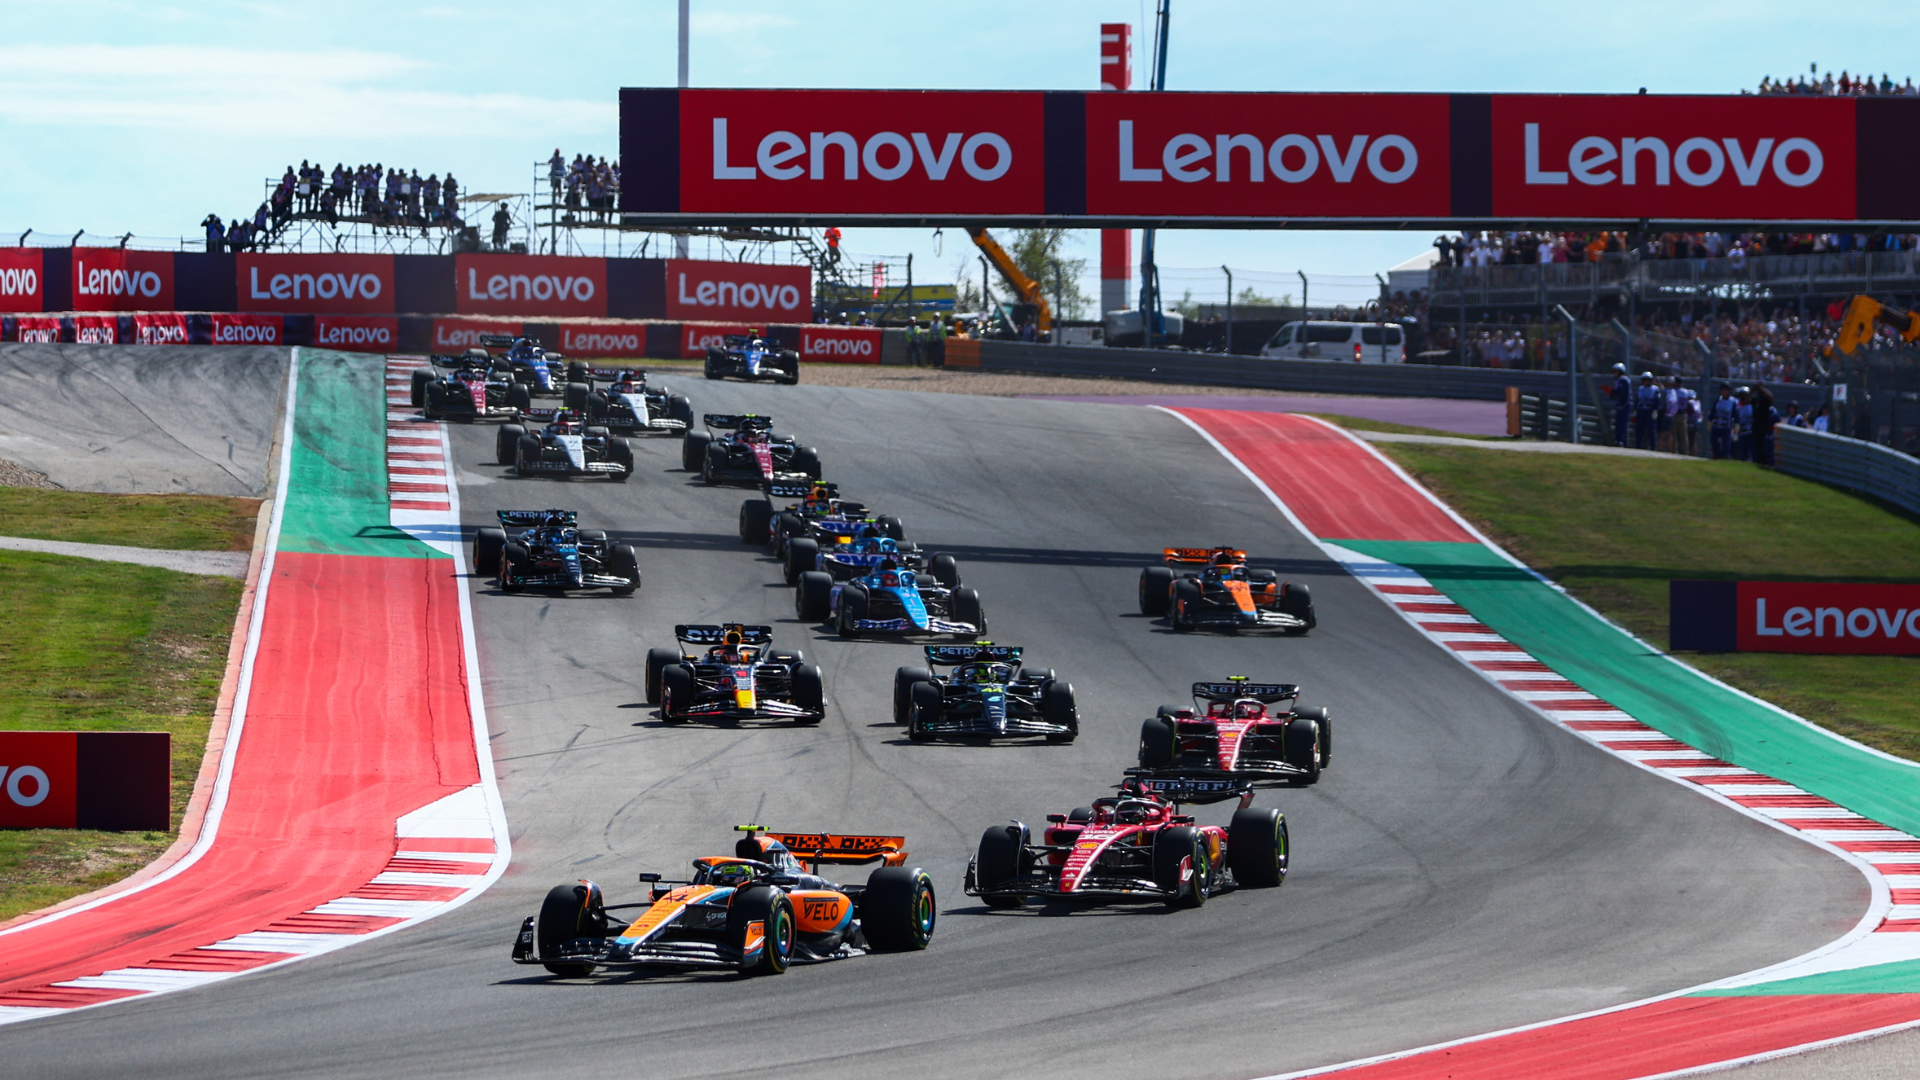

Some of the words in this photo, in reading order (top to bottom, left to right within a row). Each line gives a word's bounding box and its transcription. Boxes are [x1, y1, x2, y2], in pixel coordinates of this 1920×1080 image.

[713, 117, 1012, 181] Lenovo
[1119, 119, 1418, 183] Lenovo
[1524, 122, 1824, 187] Lenovo
[78, 261, 161, 298] Lenovo
[250, 266, 381, 299] Lenovo
[469, 267, 594, 301] Lenovo
[678, 272, 799, 310] Lenovo
[19, 325, 57, 343] Lenovo
[76, 323, 114, 344] Lenovo
[135, 322, 184, 344] Lenovo
[215, 321, 276, 343] Lenovo
[319, 323, 390, 344] Lenovo
[437, 325, 514, 346] Len
[564, 329, 638, 351] Lenovo
[688, 330, 723, 350] Len
[804, 334, 872, 356] Lenovo
[940, 647, 1008, 655] PETRAS
[804, 903, 839, 921] VELO
